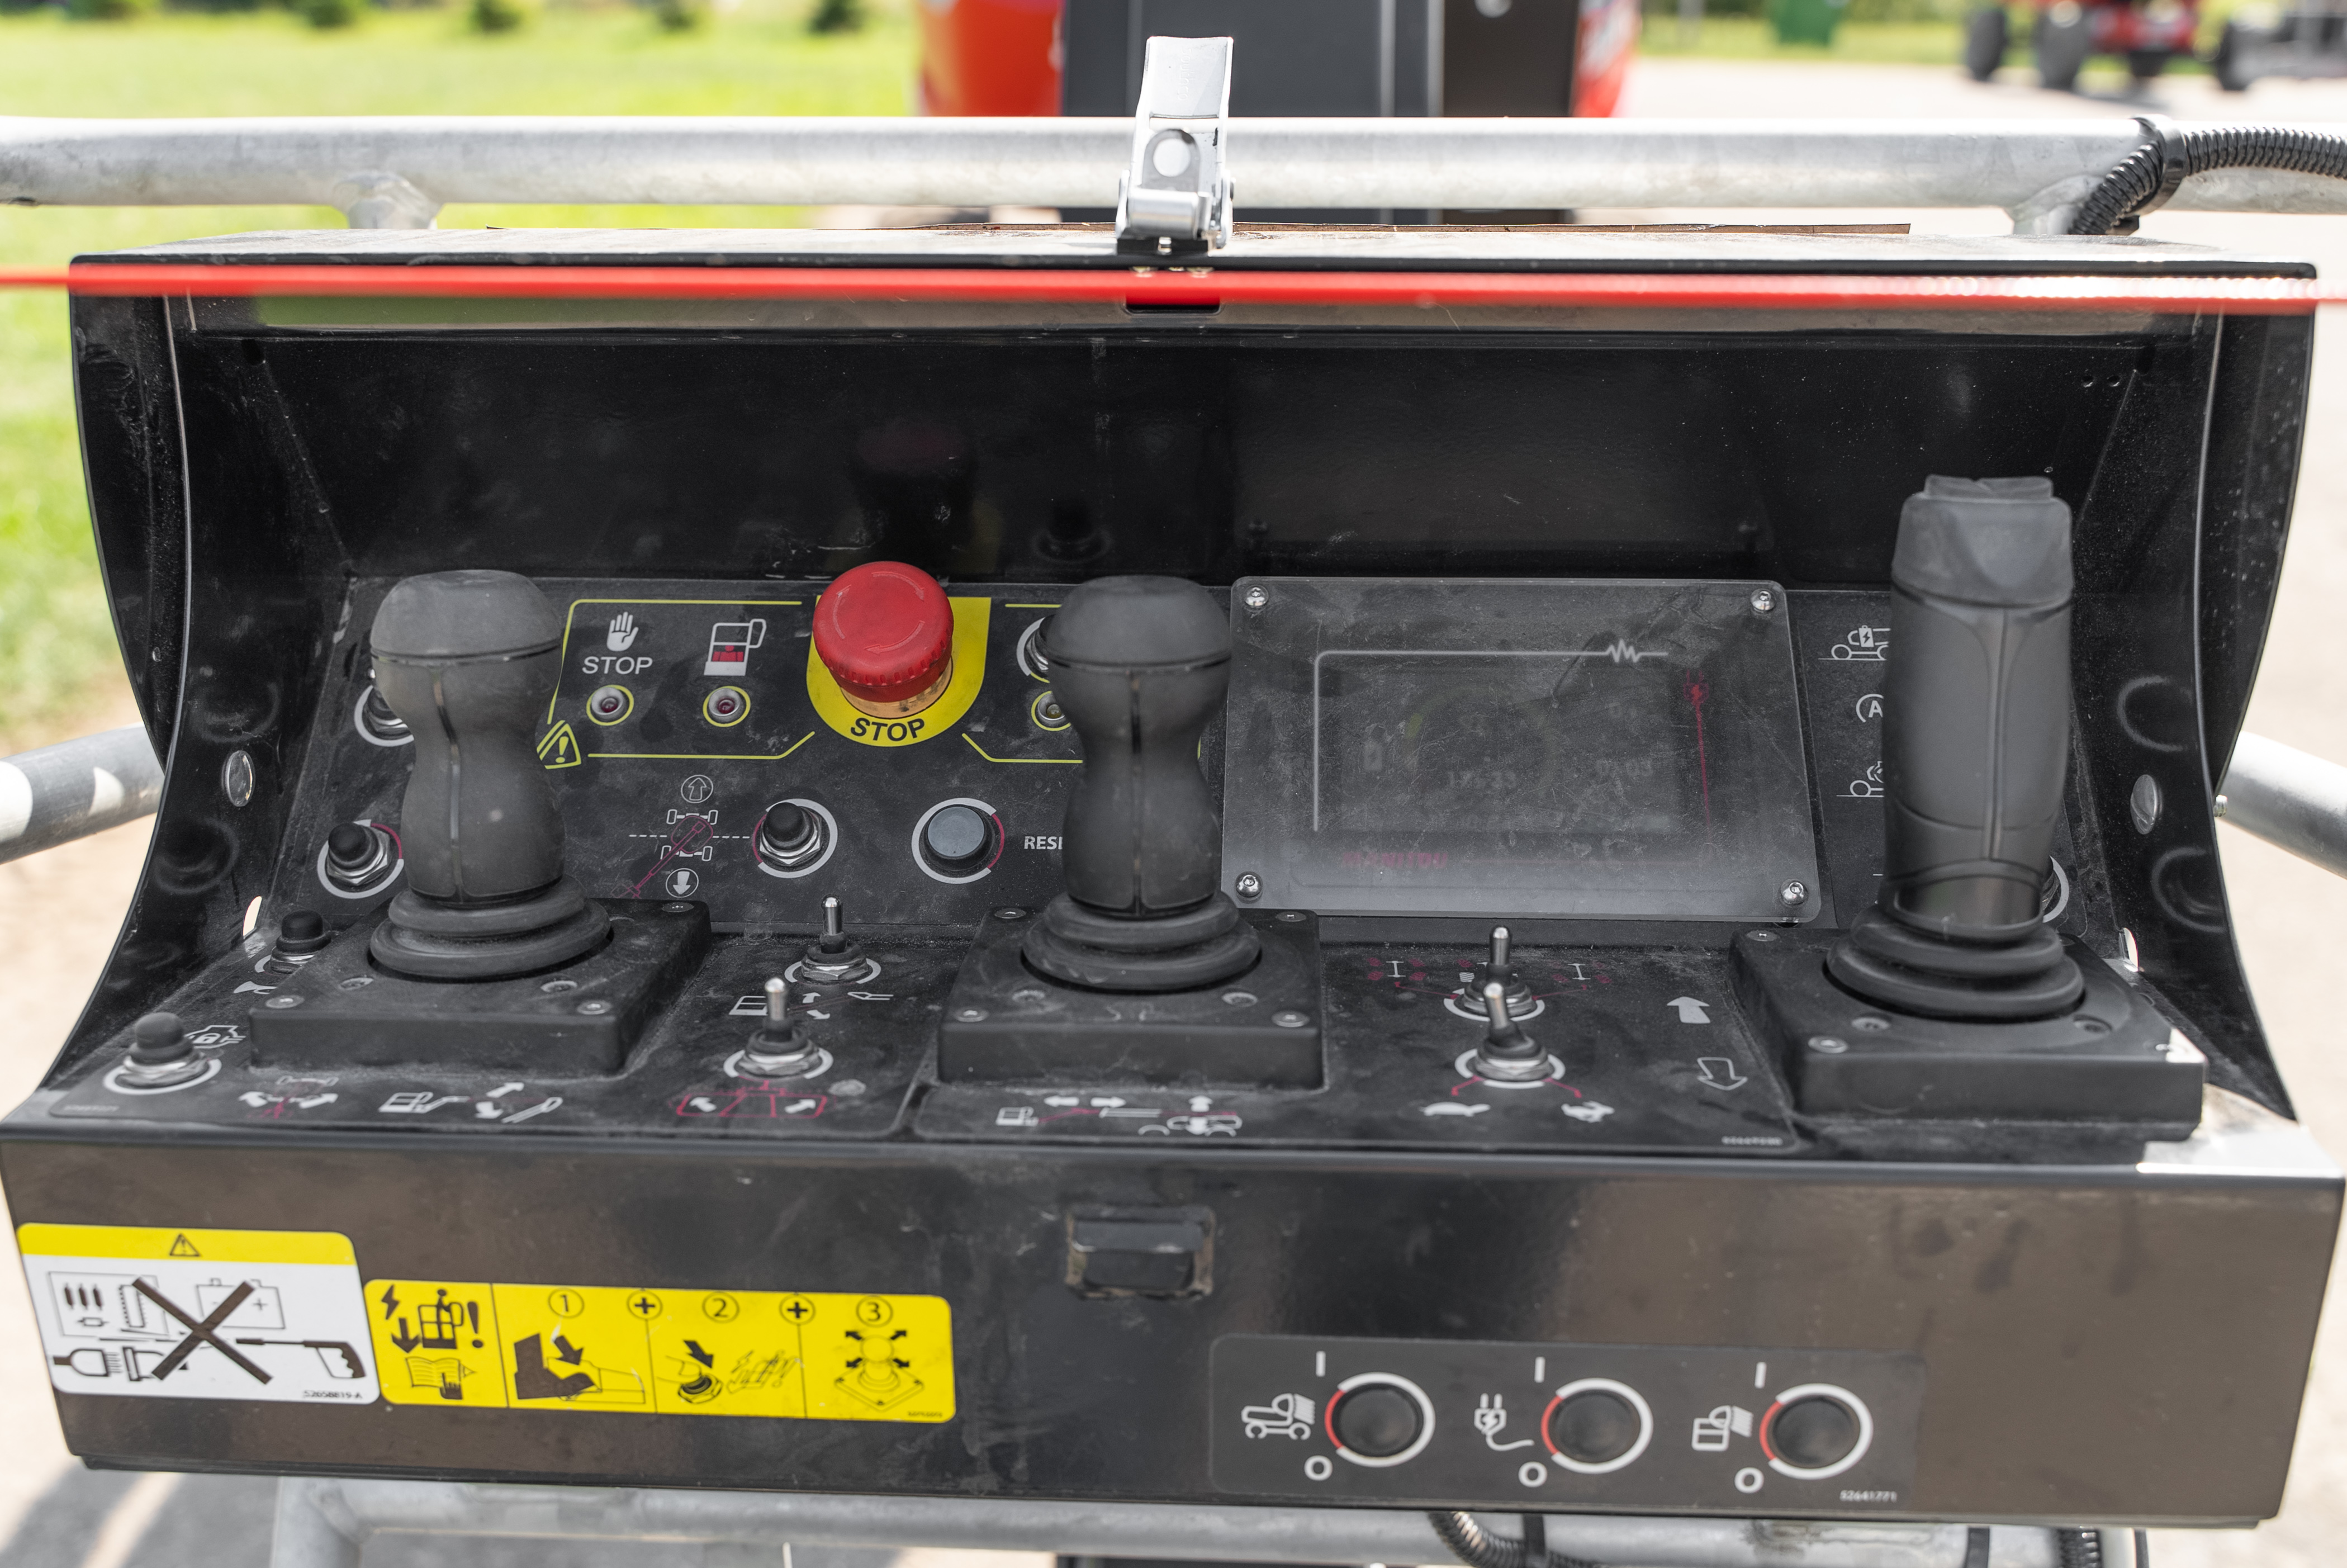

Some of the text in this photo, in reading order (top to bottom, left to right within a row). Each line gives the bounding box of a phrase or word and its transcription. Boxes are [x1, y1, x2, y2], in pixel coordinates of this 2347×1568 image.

[1177, 47, 1196, 101] southco
[582, 656, 653, 675] STOP
[850, 717, 925, 742] STOP
